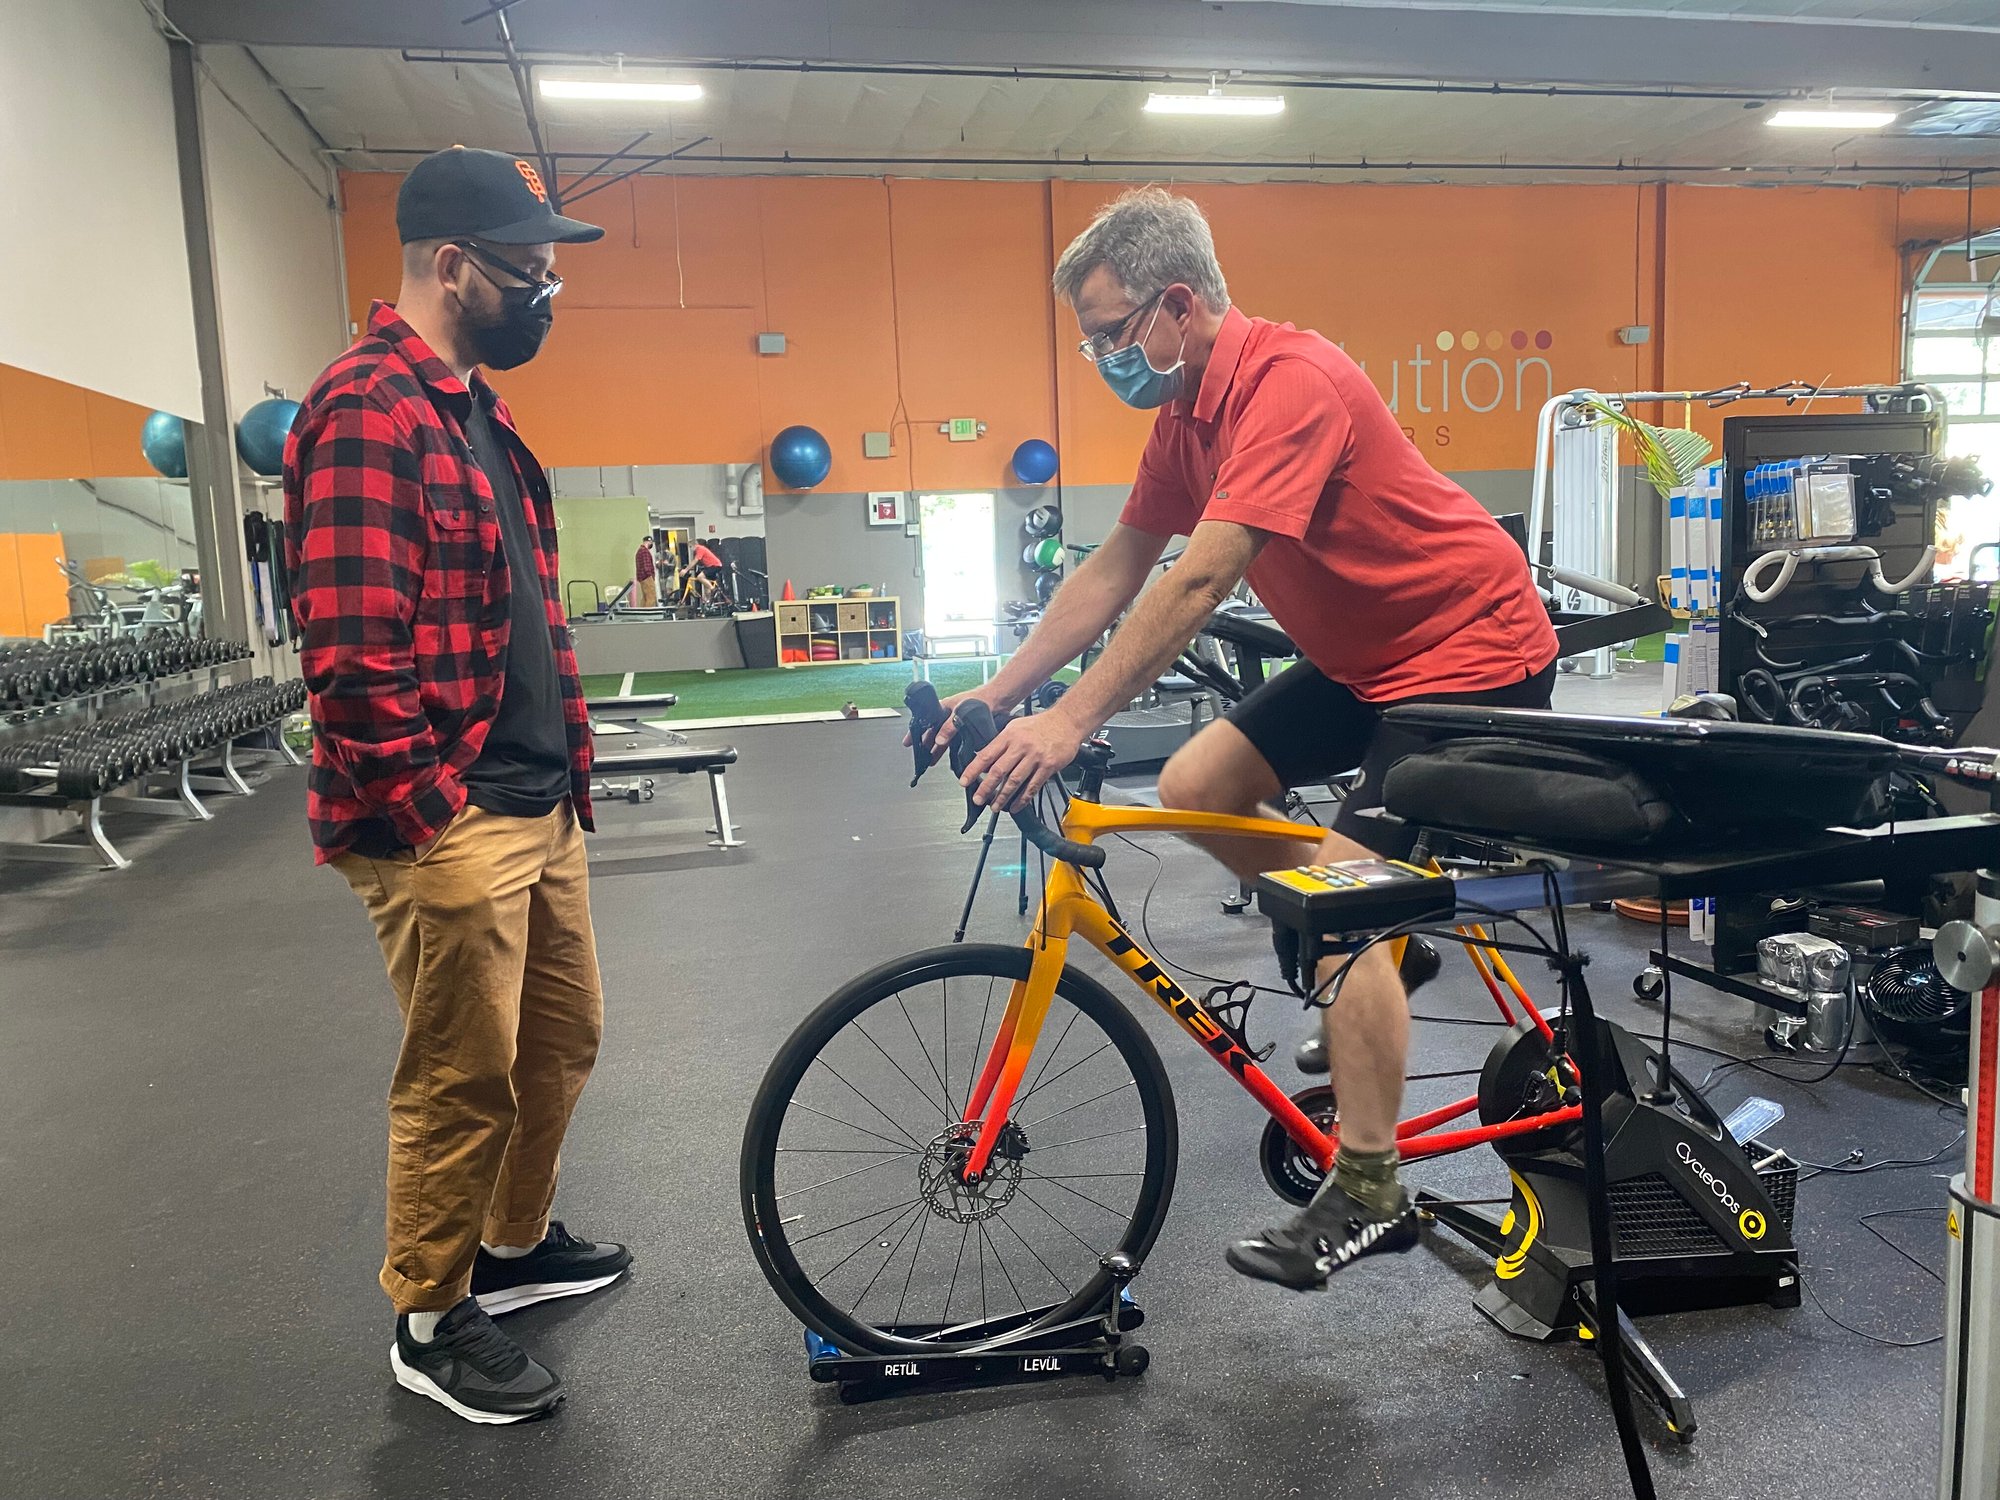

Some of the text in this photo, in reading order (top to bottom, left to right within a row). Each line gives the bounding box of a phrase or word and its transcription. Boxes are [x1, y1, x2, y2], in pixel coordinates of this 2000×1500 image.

[1340, 341, 1553, 413] ution
[955, 420, 972, 434] EXIT
[1105, 920, 1257, 1080] TREK
[1676, 1142, 1741, 1214] CycleOps
[884, 1356, 1061, 1376] RETÜL LEVÜL
